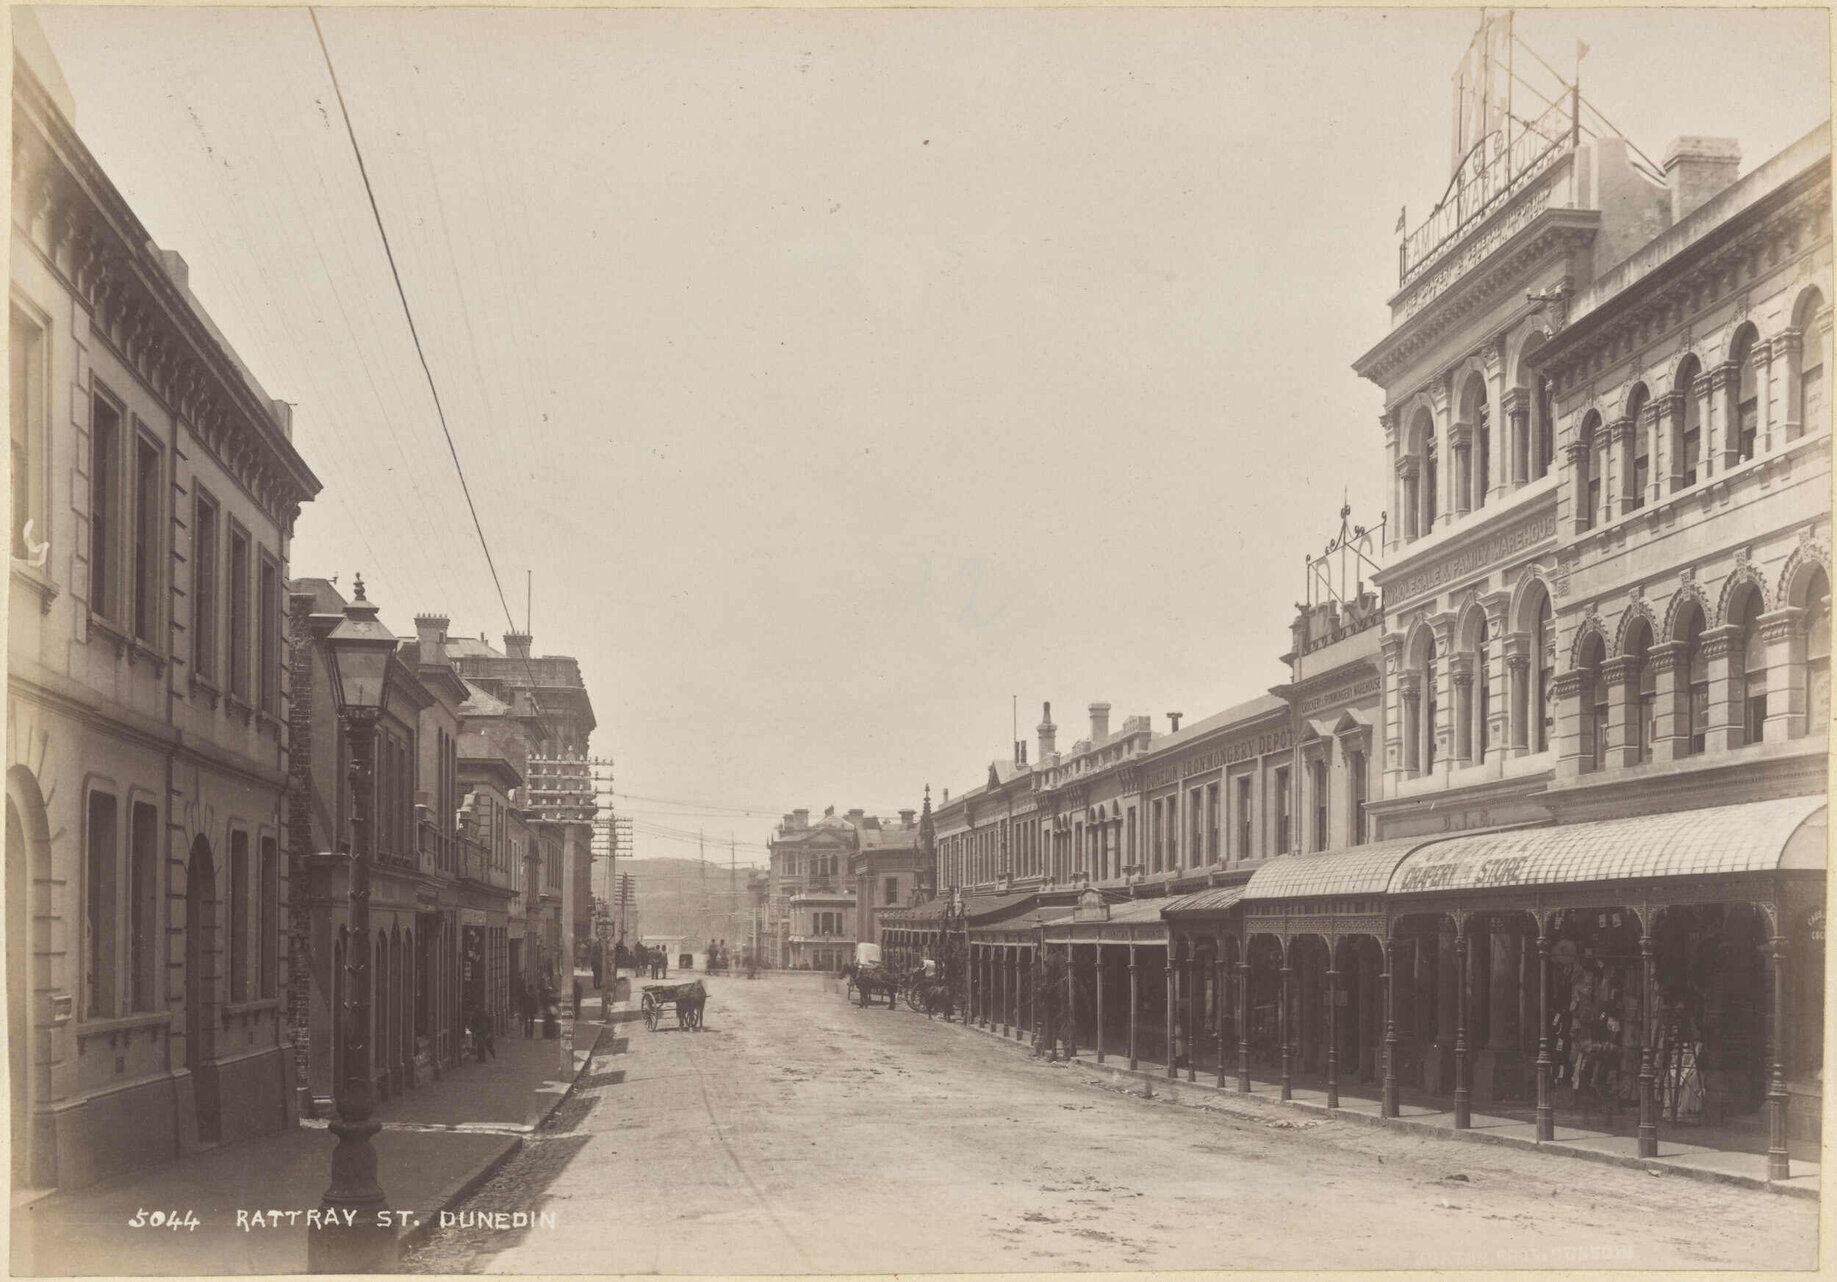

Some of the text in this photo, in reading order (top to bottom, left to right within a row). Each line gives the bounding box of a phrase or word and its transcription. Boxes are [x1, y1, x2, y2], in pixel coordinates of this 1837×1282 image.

[1385, 569, 1440, 604] WHOLESALE
[1452, 550, 1487, 579] FAMILY
[1258, 728, 1294, 754] DEPOT
[1475, 856, 1528, 882] STORE
